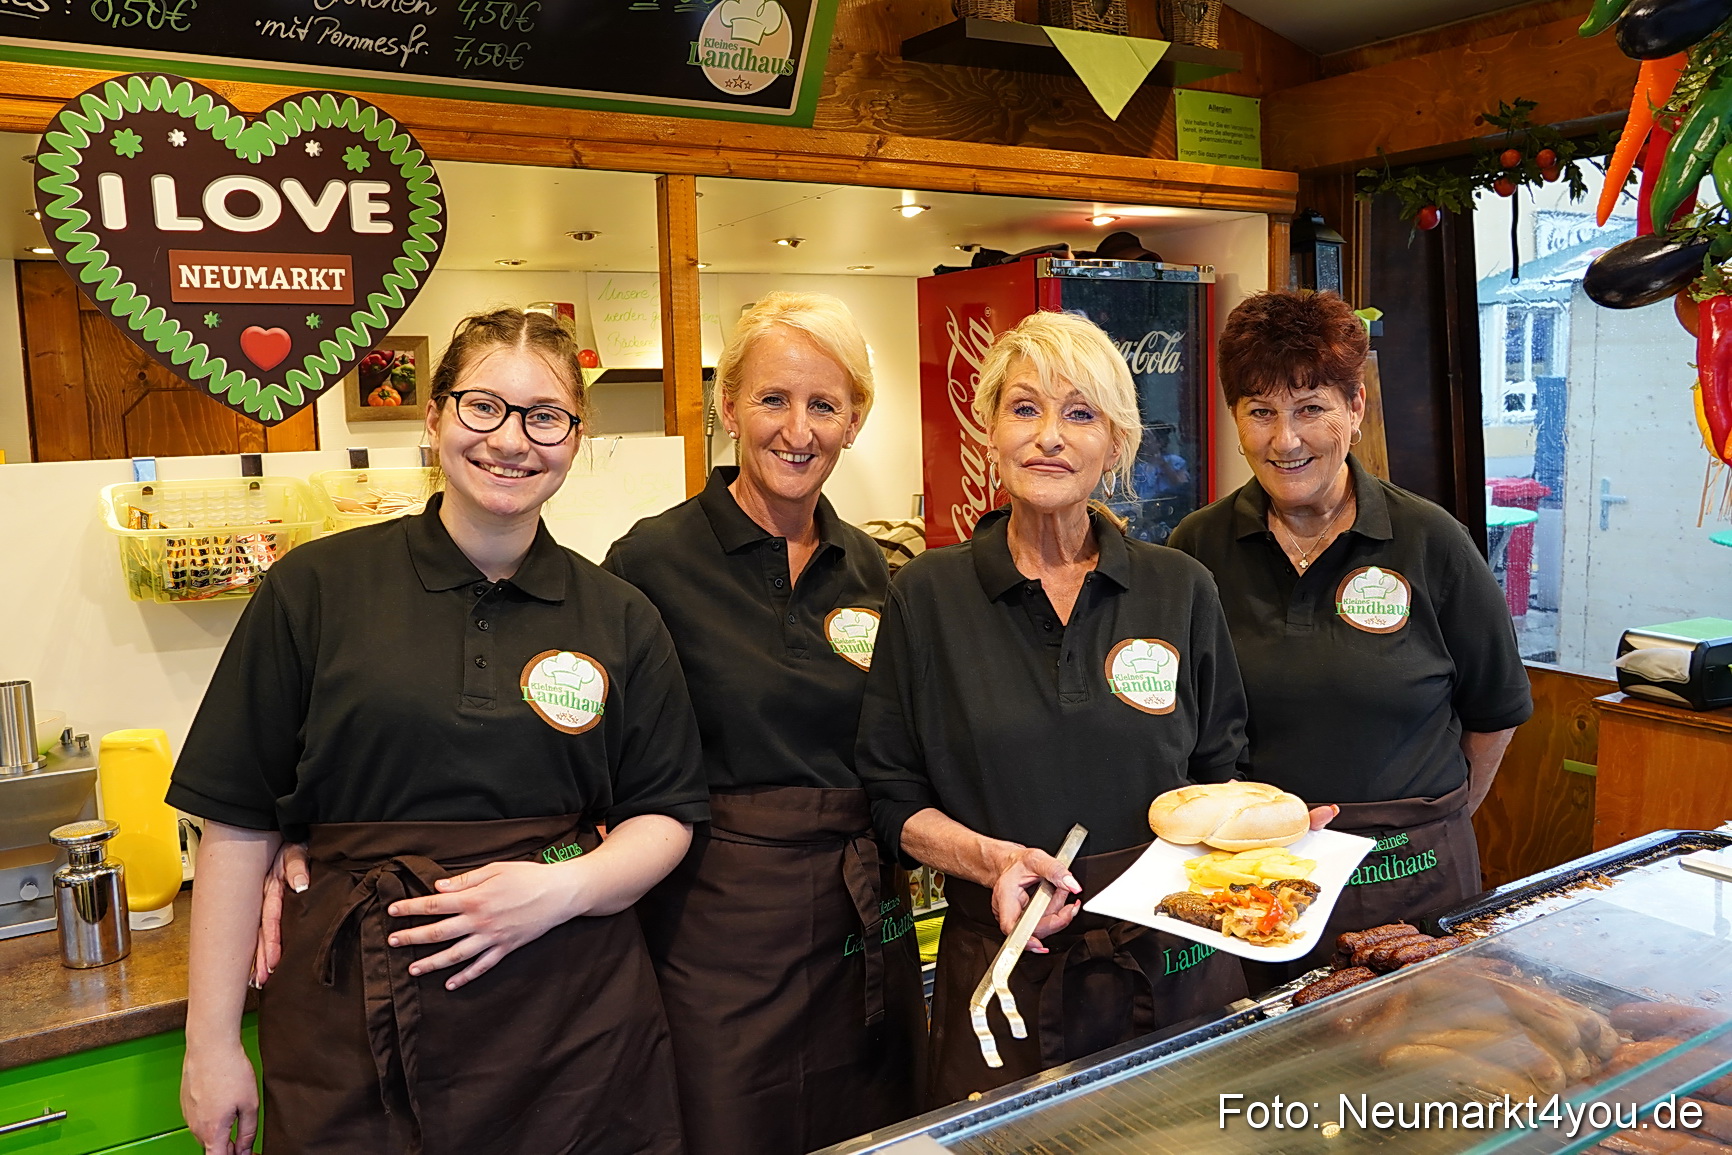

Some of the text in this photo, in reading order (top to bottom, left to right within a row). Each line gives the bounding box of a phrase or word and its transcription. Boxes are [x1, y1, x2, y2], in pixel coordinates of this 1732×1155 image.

[457, 0, 541, 33] 4,50€
[260, 15, 315, 41] mit
[314, 16, 399, 55] Pommes
[453, 36, 532, 70] 7,50€
[703, 37, 739, 51] Kleines
[686, 41, 795, 76] Landhaus
[97, 173, 394, 234] I LOVE
[179, 264, 346, 291] NEUMARKT
[598, 278, 650, 301] Unsere
[603, 308, 647, 323] werden
[1113, 331, 1187, 375] ca-Cola
[1336, 602, 1411, 617] Landhaus
[828, 640, 874, 653] Landh
[522, 685, 605, 715] Landhaus
[1369, 832, 1410, 852] leines
[1344, 849, 1438, 887] andhaus
